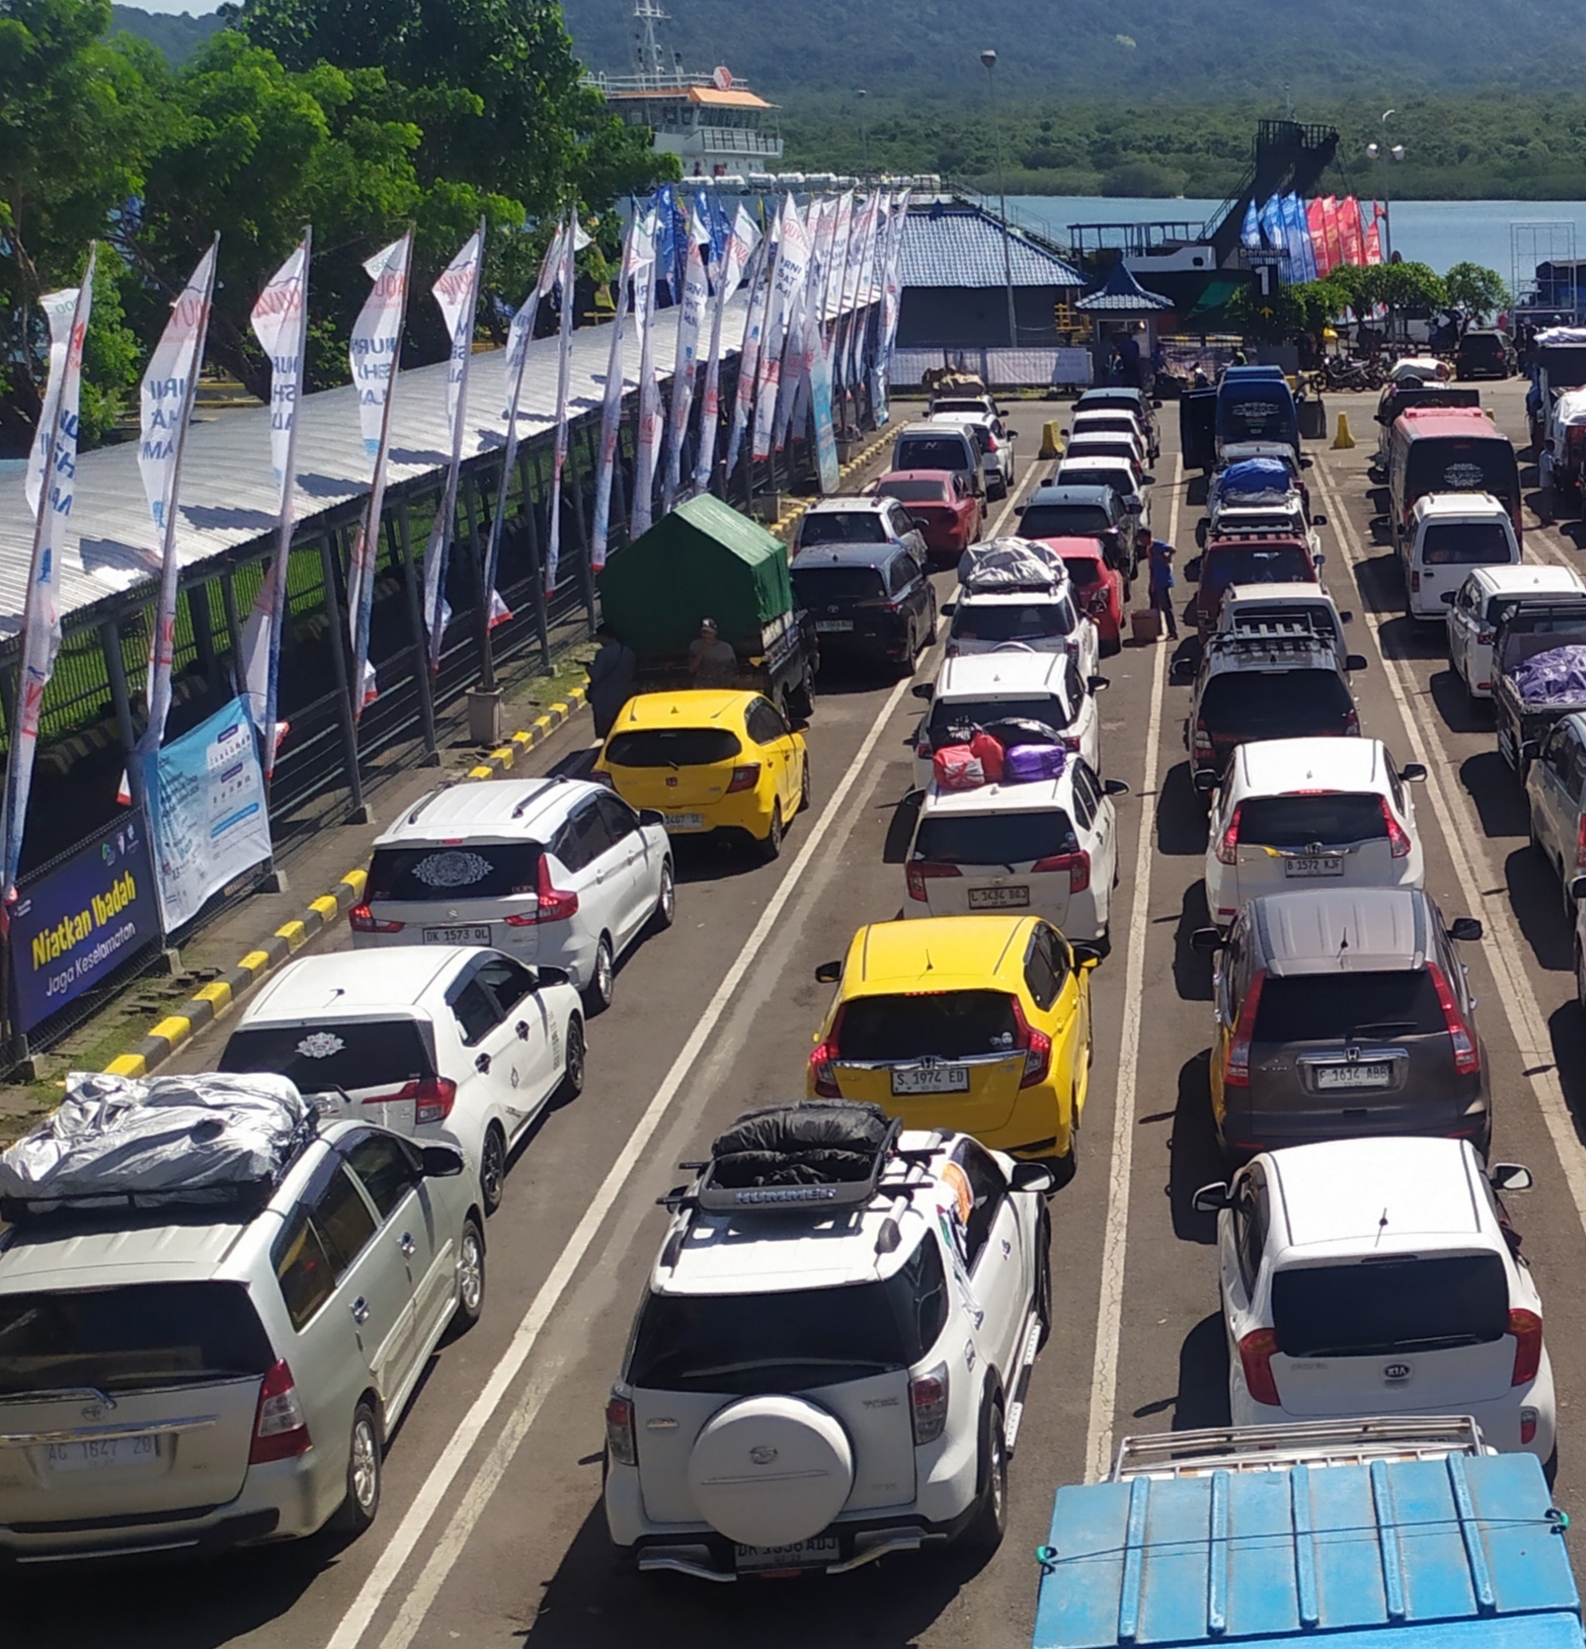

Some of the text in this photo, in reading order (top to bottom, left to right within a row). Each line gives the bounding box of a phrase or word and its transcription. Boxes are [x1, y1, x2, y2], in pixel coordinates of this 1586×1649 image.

[1255, 265, 1269, 296] 1
[1296, 860, 1320, 871] 1572
[31, 869, 137, 972] Niatkan Ibadah
[426, 931, 440, 943] DK
[444, 929, 470, 941] 1573
[45, 921, 137, 997] Jaga Keselamatan
[896, 1068, 964, 1087] S 1974 ED
[1386, 1365, 1407, 1377] KIA
[81, 1438, 118, 1460] 1647
